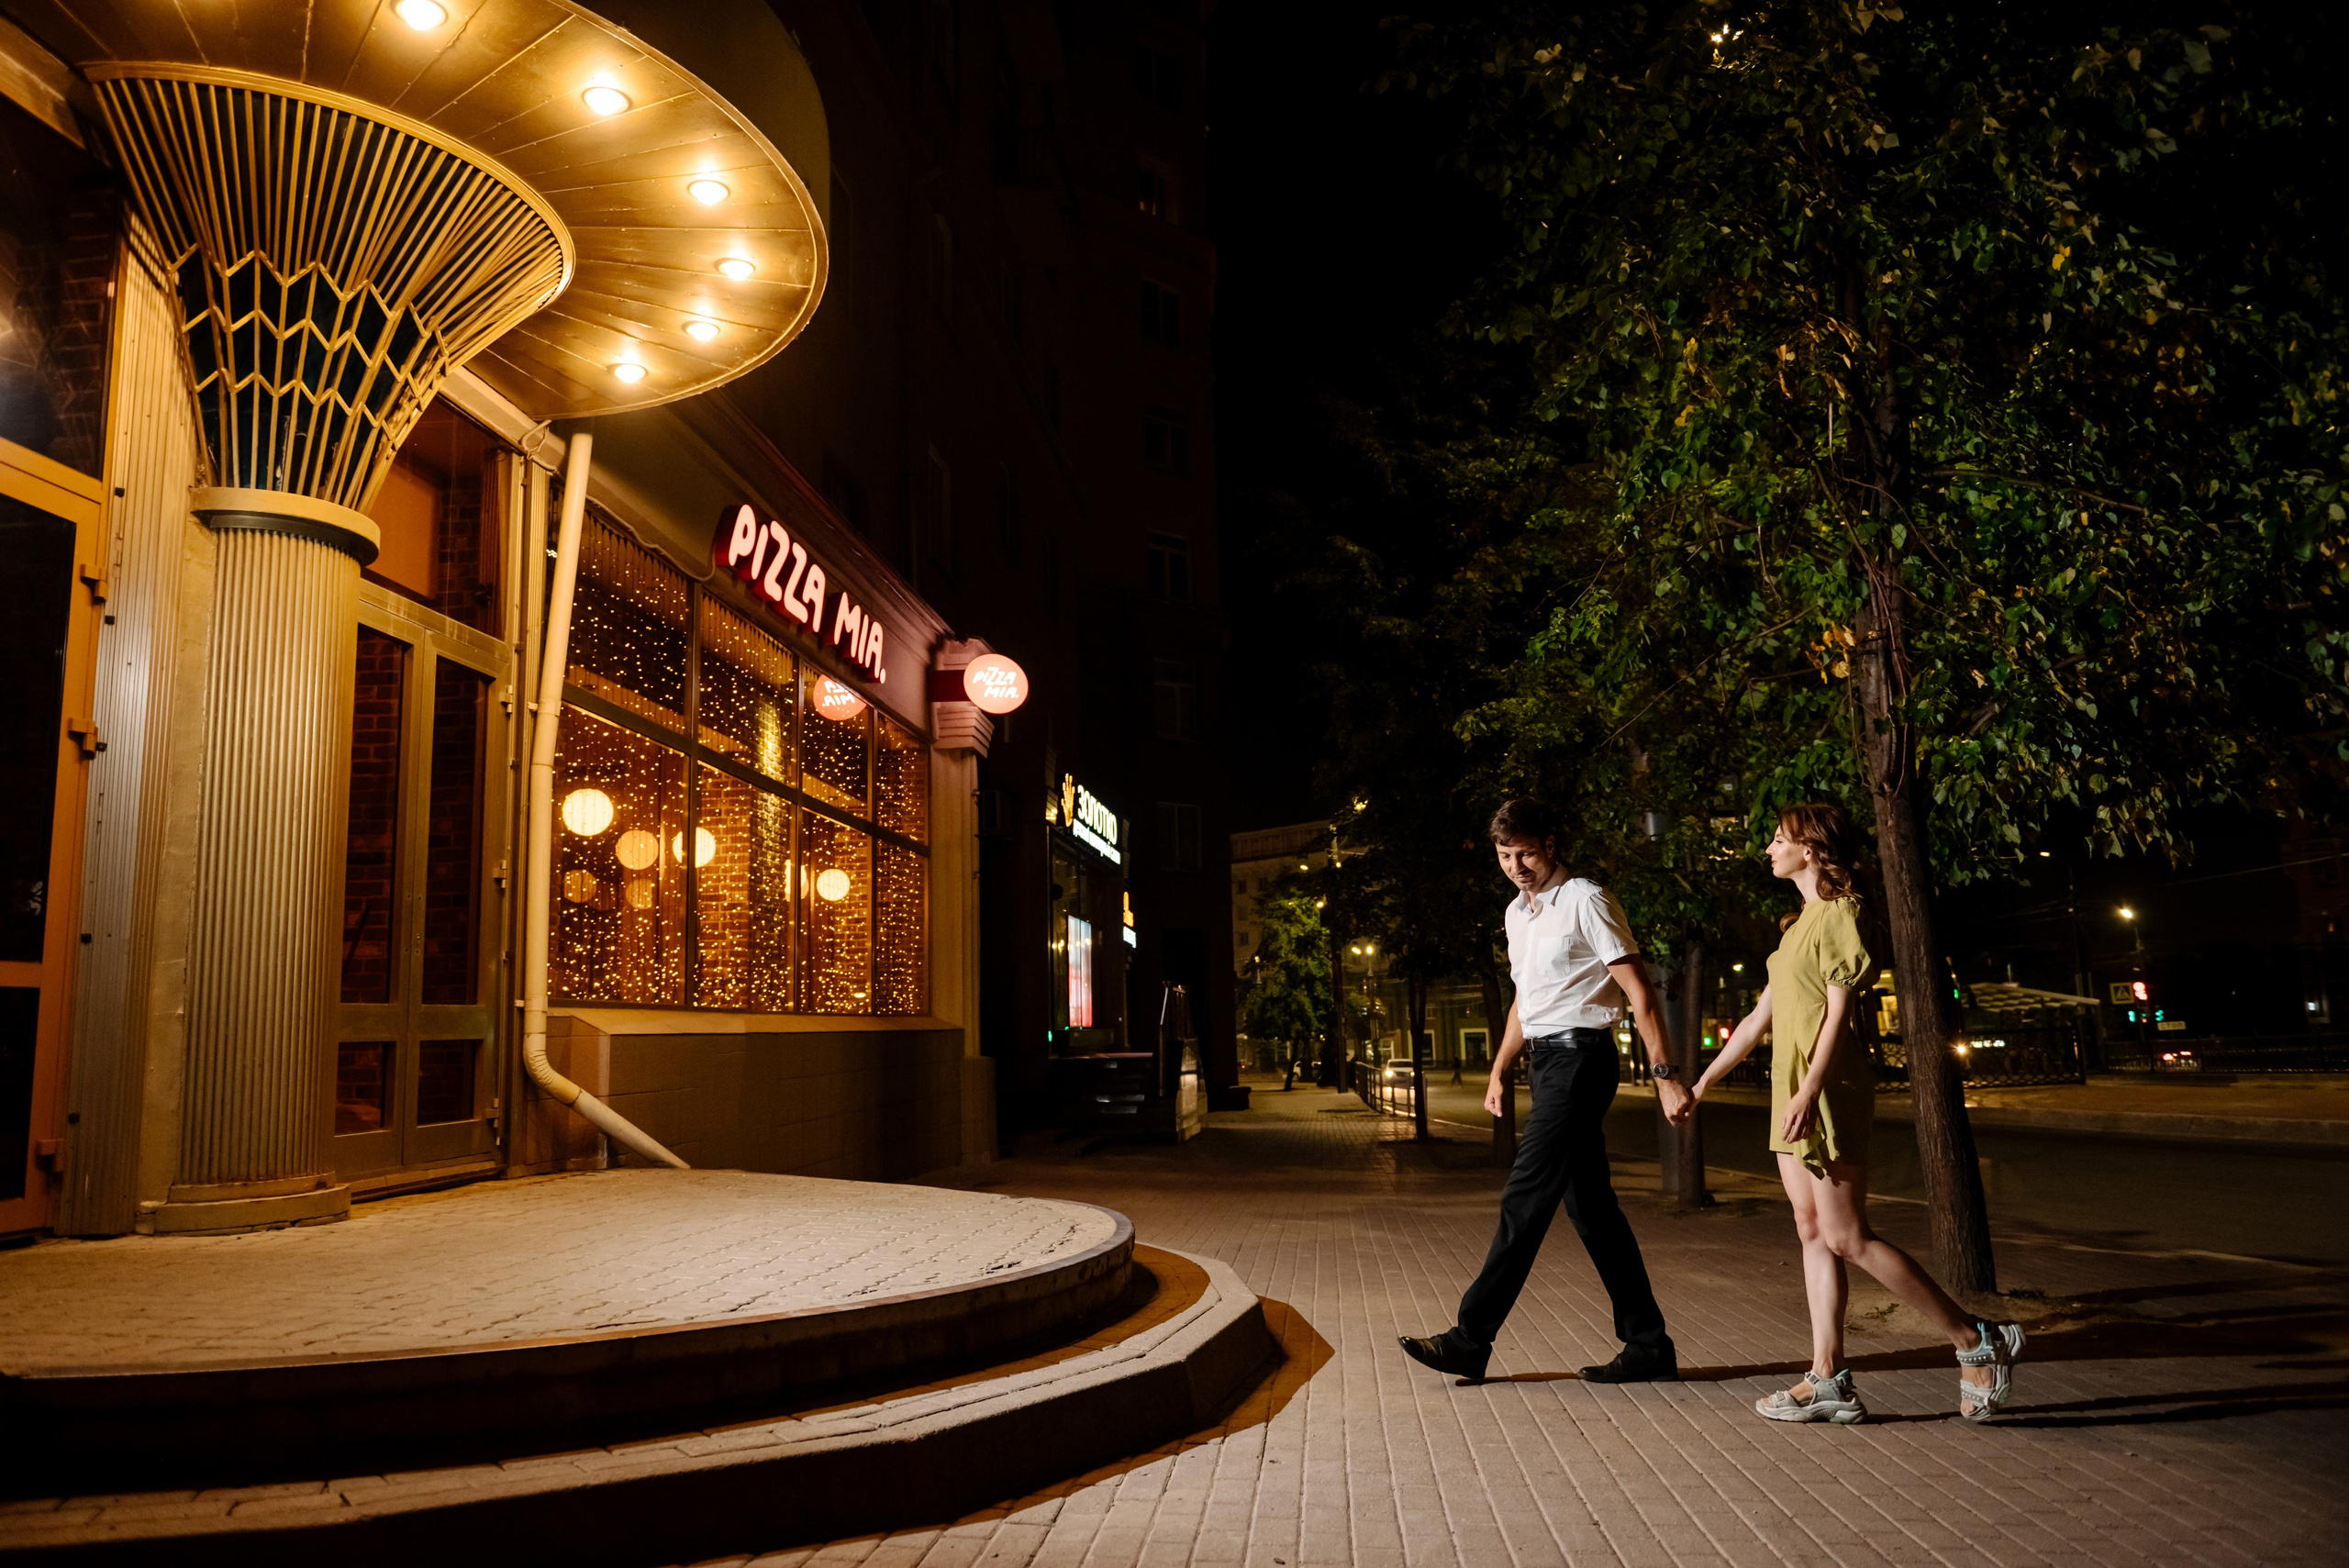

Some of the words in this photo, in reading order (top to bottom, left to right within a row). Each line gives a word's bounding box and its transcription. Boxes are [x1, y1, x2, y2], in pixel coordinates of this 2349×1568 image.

[729, 504, 827, 633] PIZZA
[833, 591, 886, 684] MIA.
[973, 666, 1017, 686] PIZZA
[984, 685, 1019, 698] MIA.
